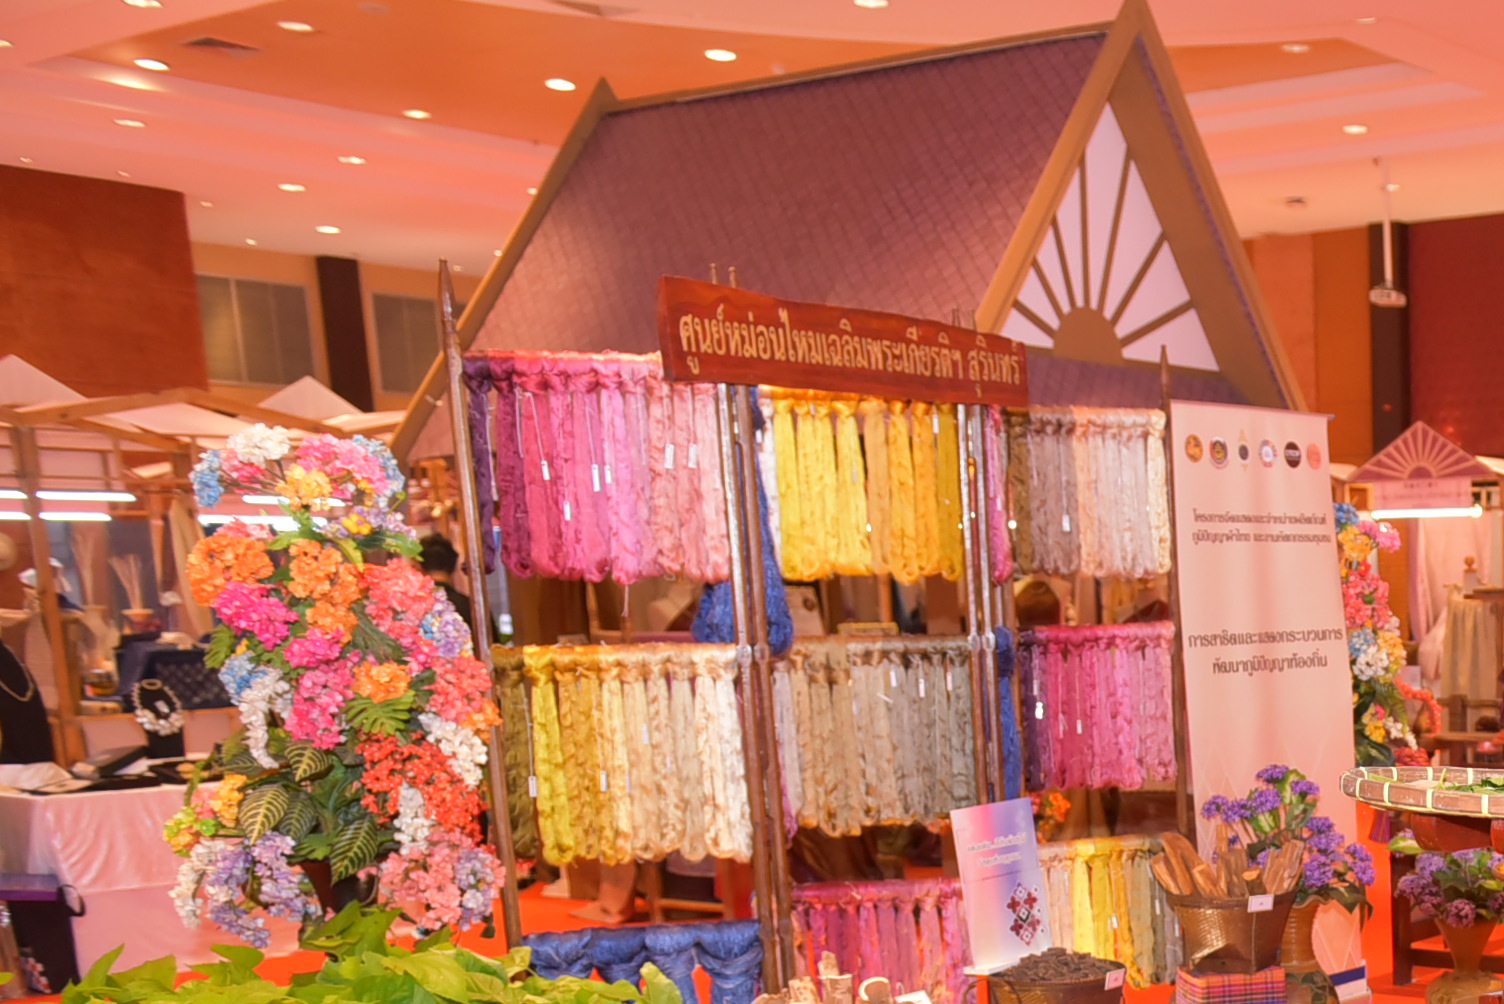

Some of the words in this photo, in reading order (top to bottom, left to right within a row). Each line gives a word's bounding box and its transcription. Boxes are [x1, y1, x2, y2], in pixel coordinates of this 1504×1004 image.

[679, 304, 963, 379] ศูนย์หม่อนไหมเฉลิมพระเกียรติฯ
[968, 335, 1020, 398] สุรินทร์
[1187, 628, 1343, 648] การสาธิตและแสดงกระบวนการ
[1212, 648, 1328, 677] พัฒนาภูมิปัญญาท้องถิ่น
